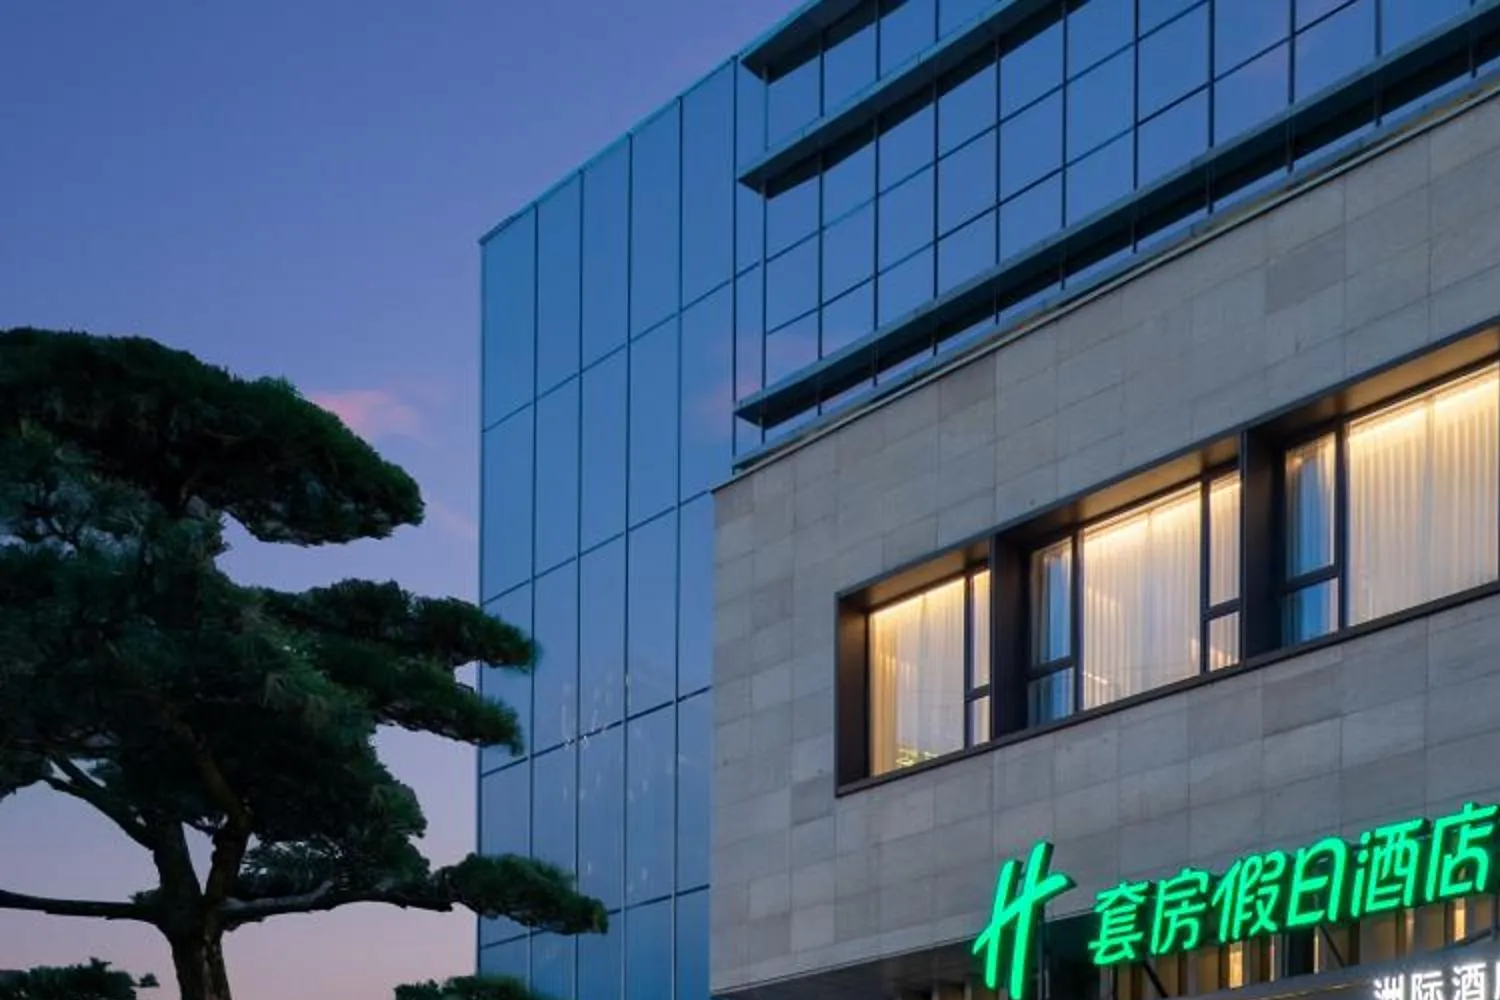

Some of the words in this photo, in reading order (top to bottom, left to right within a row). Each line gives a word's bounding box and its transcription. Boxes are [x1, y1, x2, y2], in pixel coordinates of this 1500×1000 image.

[1087, 802, 1500, 967] 套房假日酒店
